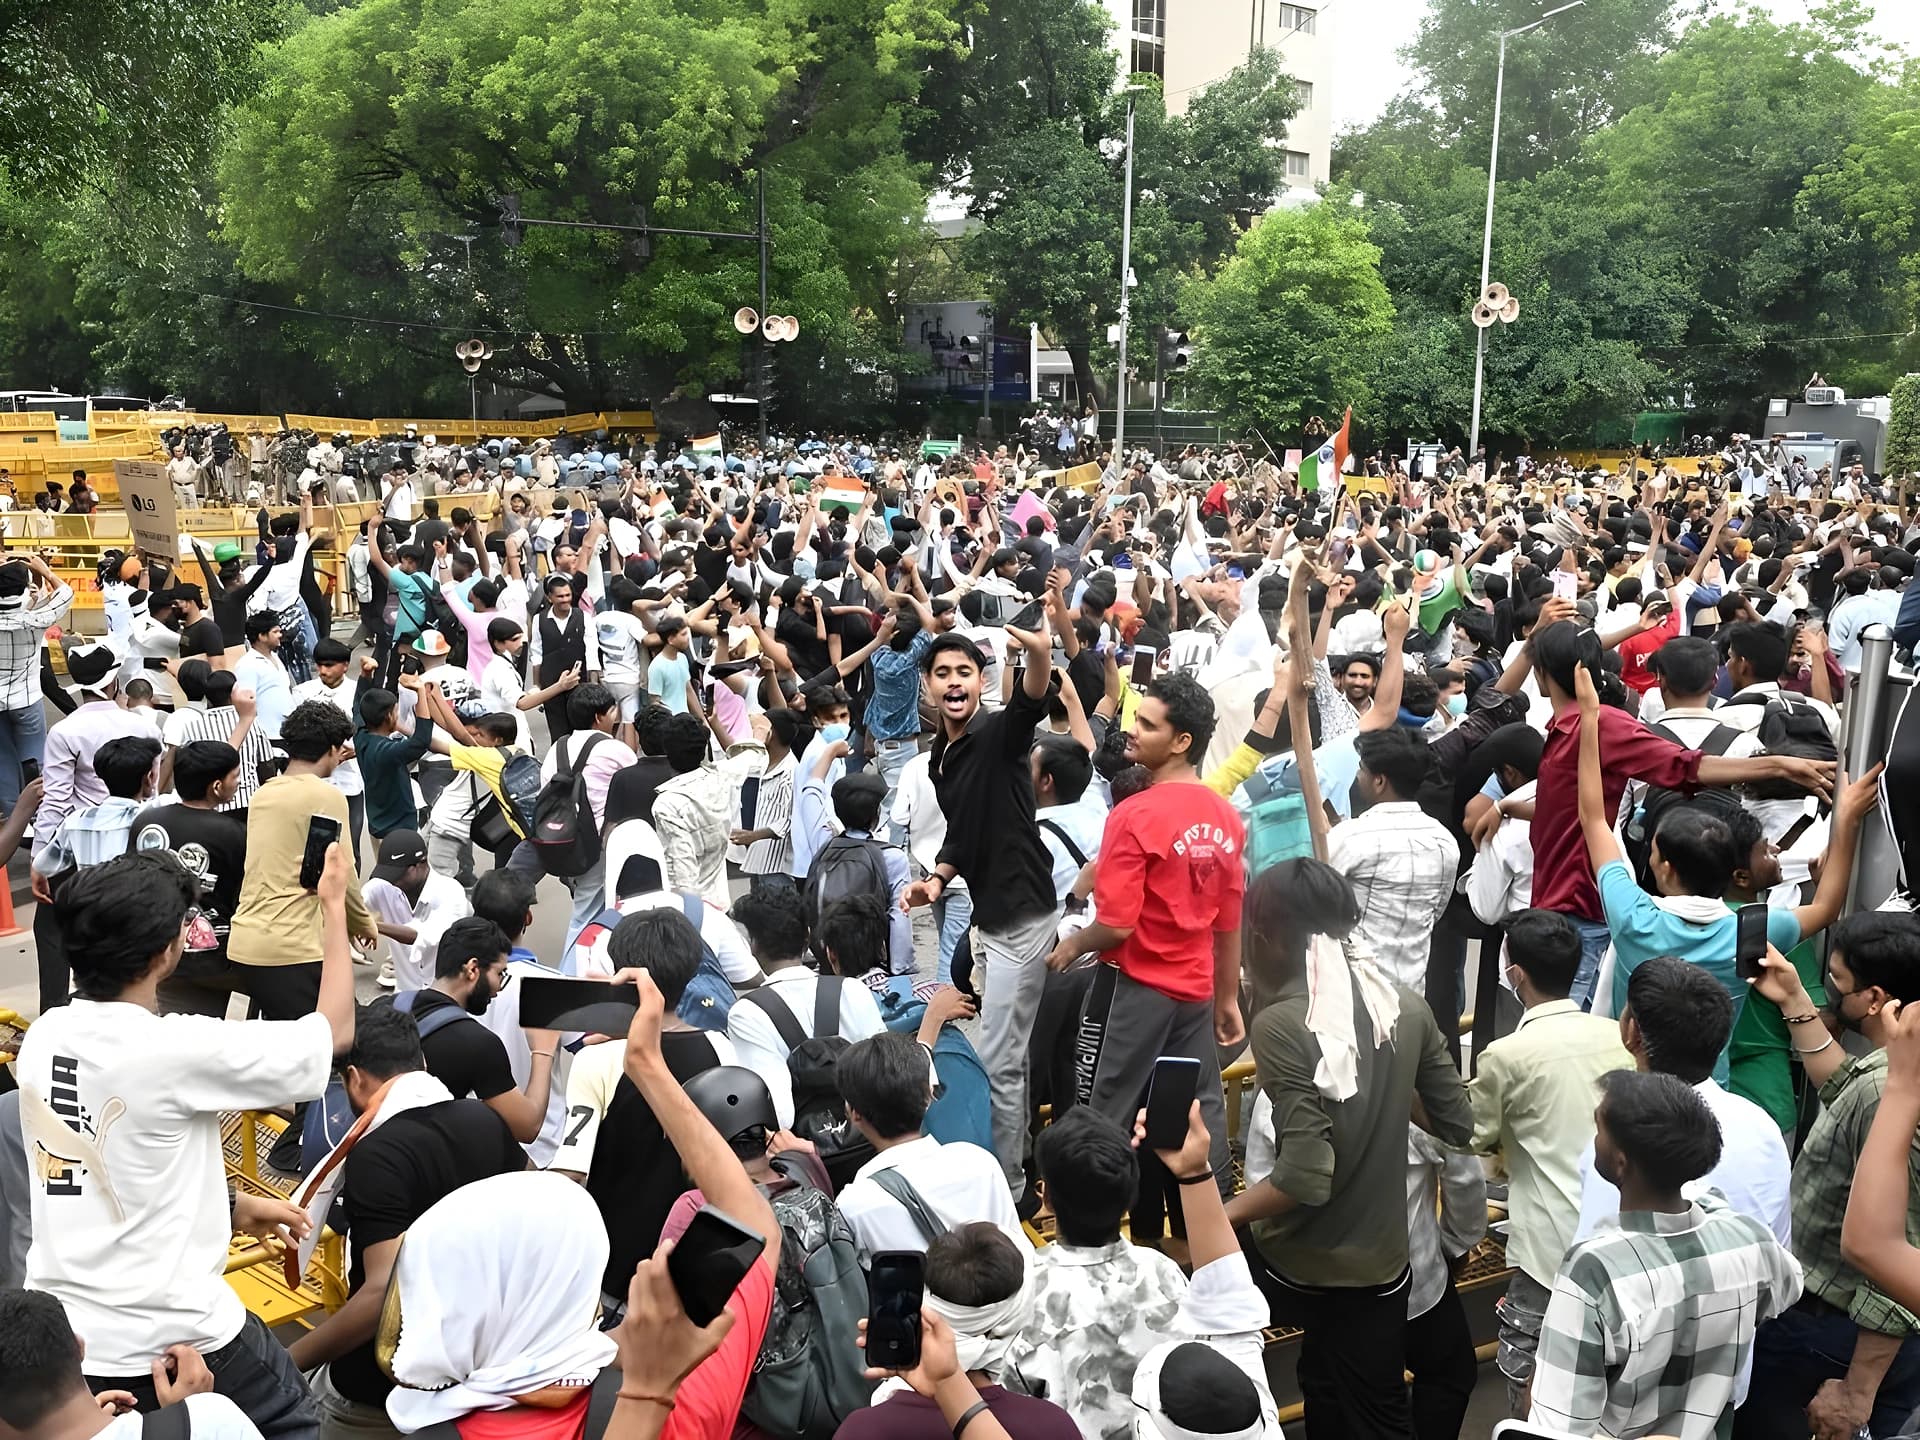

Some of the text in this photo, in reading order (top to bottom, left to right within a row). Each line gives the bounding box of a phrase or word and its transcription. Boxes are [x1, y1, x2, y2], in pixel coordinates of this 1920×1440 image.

[142, 497, 156, 511] LG
[46, 1055, 82, 1196] PMA
[563, 1105, 595, 1147] 7
